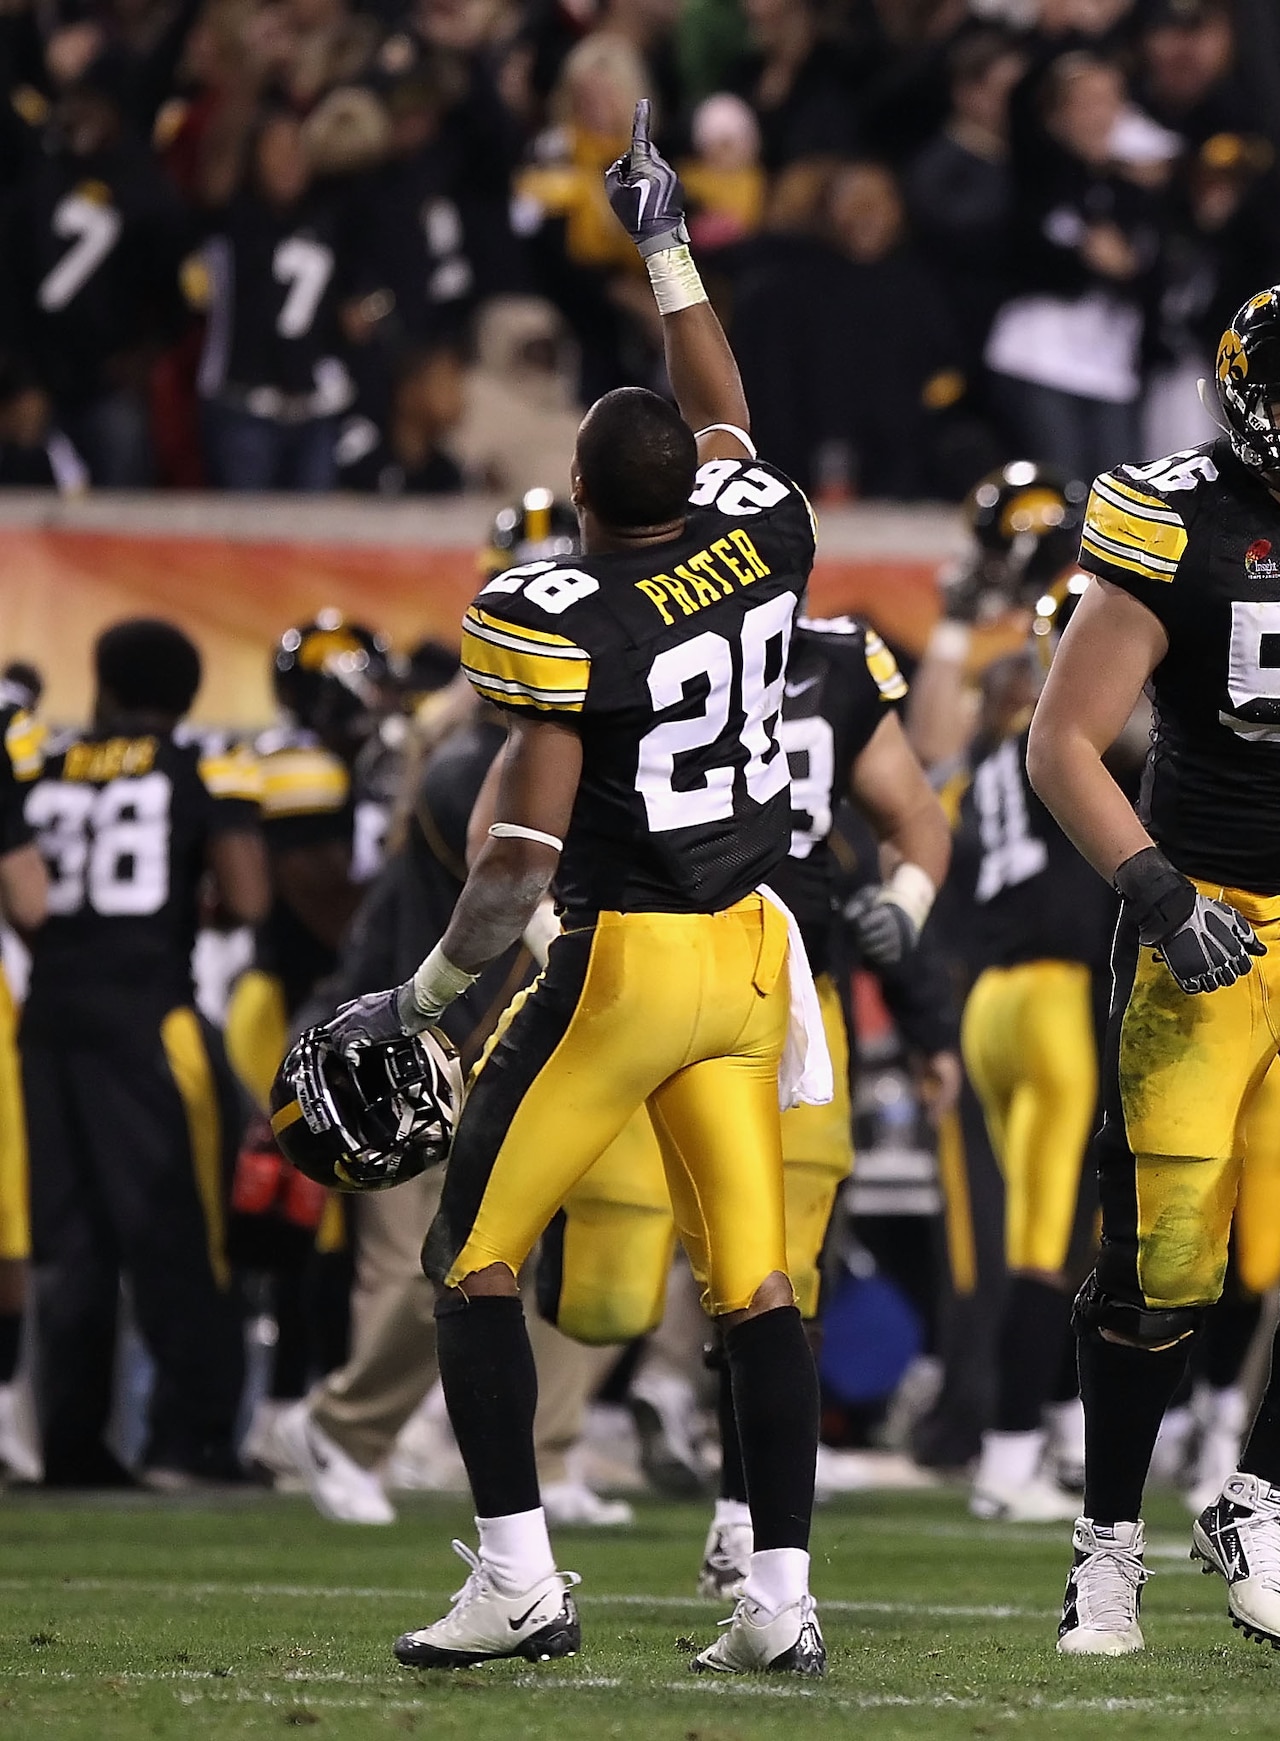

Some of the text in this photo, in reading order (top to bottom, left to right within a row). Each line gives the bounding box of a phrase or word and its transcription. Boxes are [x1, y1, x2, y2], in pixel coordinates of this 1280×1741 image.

[272, 234, 335, 339] 7
[479, 560, 600, 614] 28
[634, 529, 771, 626] PRATER
[634, 590, 798, 832] 28
